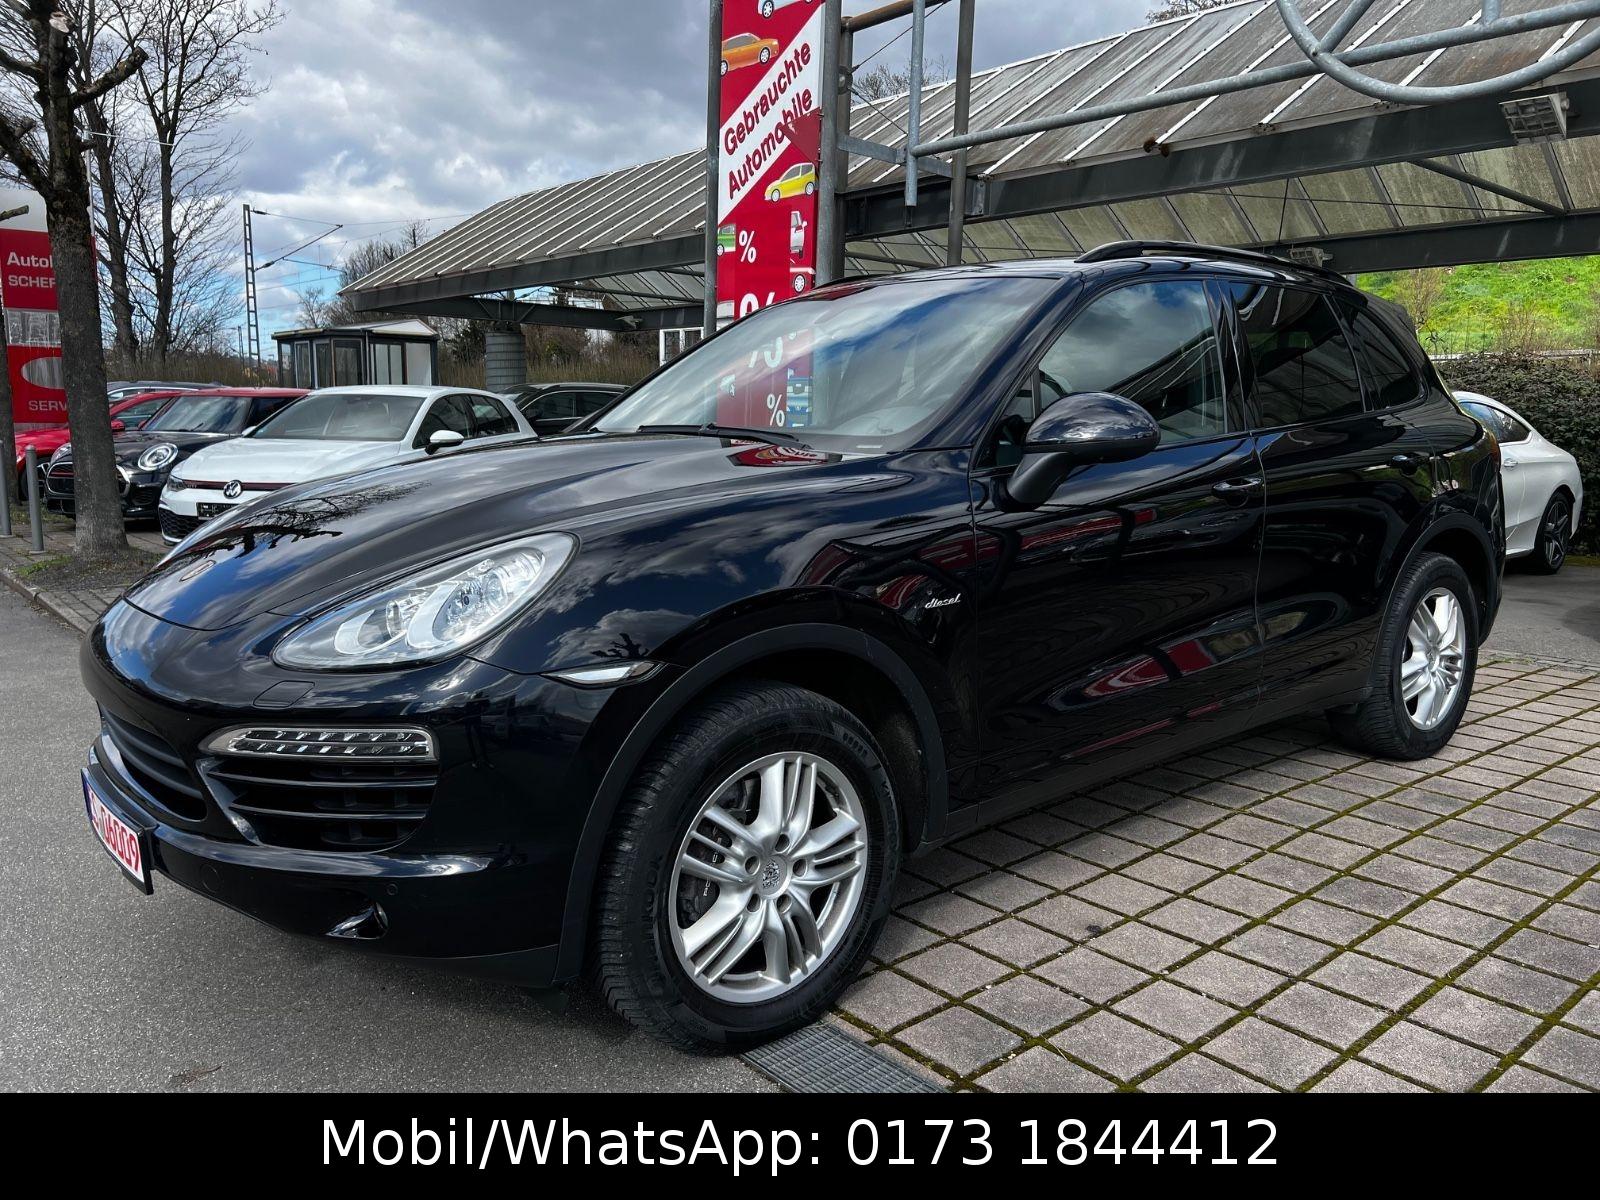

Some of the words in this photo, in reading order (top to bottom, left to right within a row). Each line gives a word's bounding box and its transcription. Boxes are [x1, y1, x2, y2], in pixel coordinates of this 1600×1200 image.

[724, 42, 811, 156] Gebrauchte
[727, 88, 813, 200] Automobile
[738, 230, 757, 263] %
[924, 593, 961, 609] diesel
